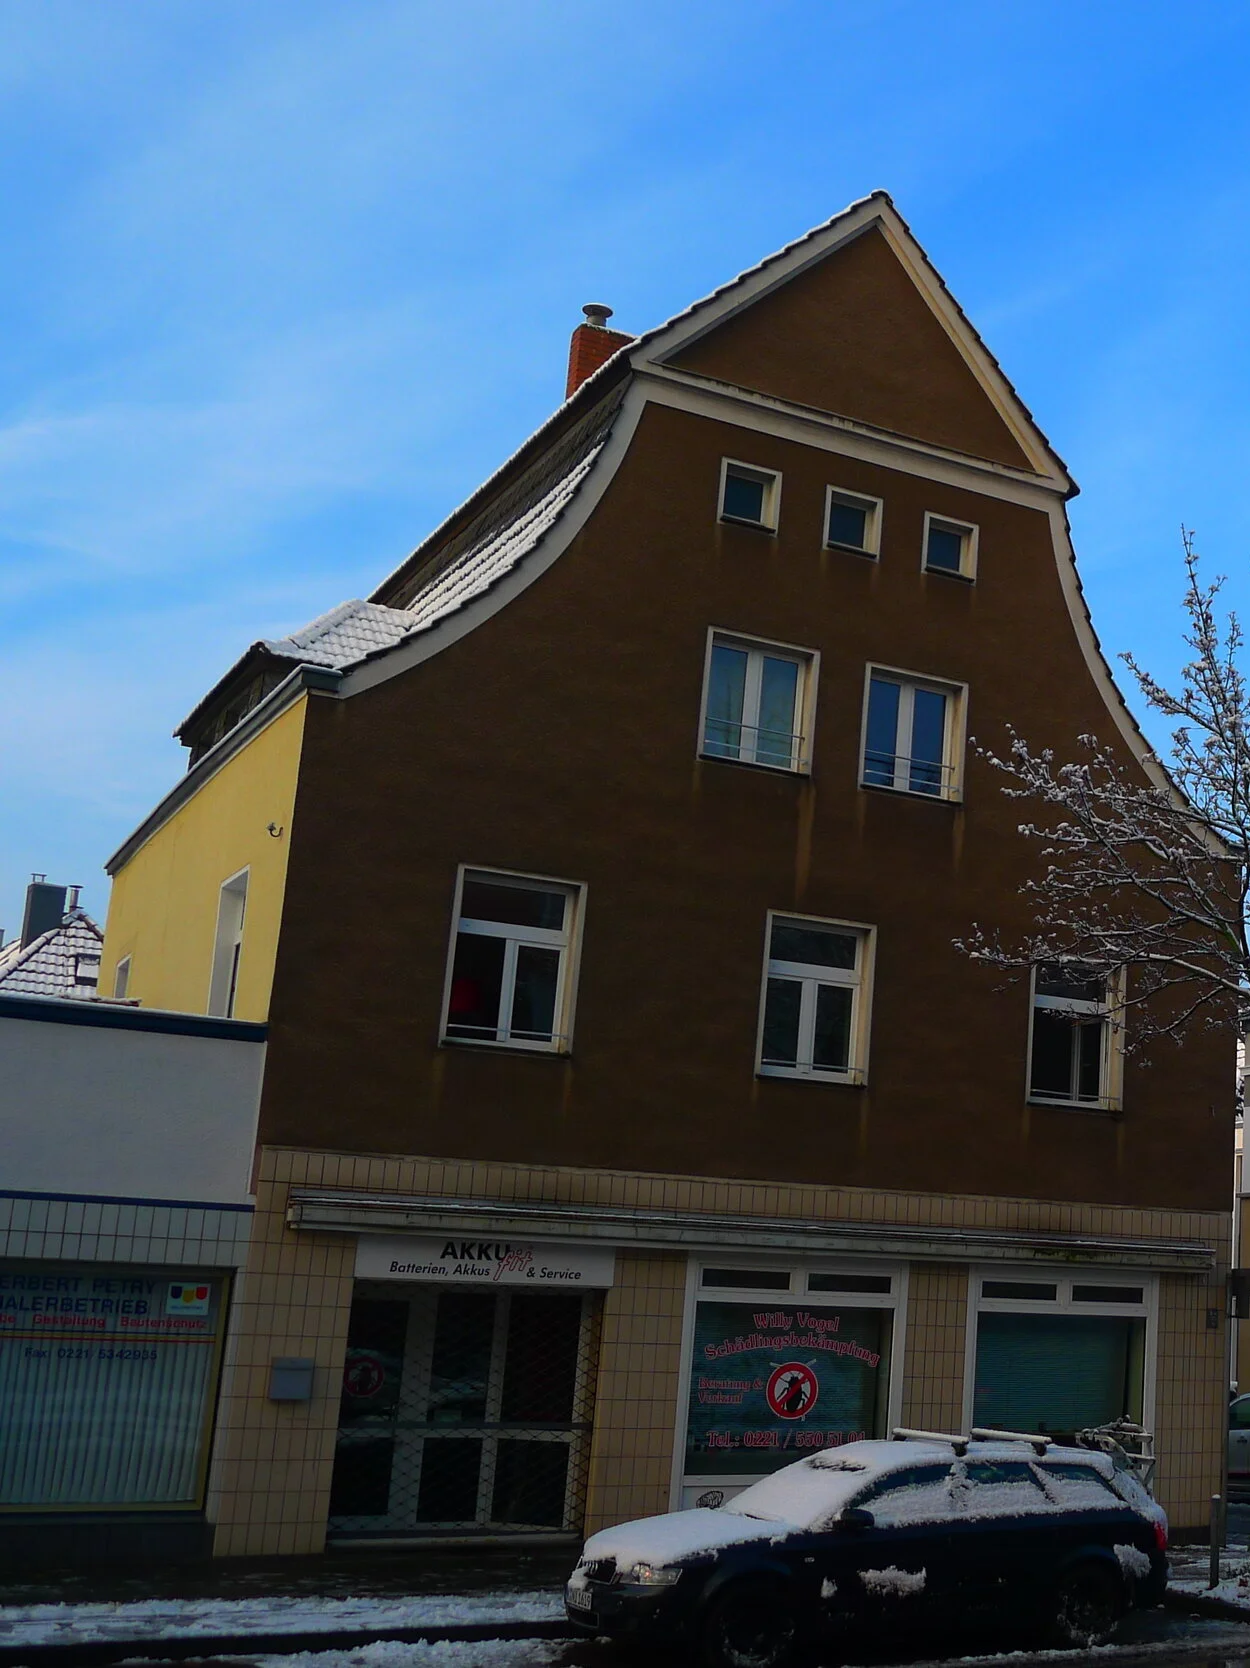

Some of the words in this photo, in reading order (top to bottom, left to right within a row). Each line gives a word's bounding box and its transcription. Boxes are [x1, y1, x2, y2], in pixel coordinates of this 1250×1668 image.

[440, 1241, 510, 1261] AKKU
[389, 1261, 449, 1277] Batterien,
[453, 1263, 491, 1277] Akkus
[526, 1266, 536, 1278] &
[539, 1267, 582, 1280] Service
[92, 1278, 157, 1295] PETRY
[33, 1313, 106, 1329] Gestaltung
[120, 1316, 208, 1330] Bautenschutz
[753, 1311, 793, 1331] Willy
[796, 1311, 840, 1333] Vogel
[57, 1348, 89, 1359] 0221
[704, 1331, 881, 1368] Schädlingsbekämpfung
[753, 1377, 763, 1389] &
[707, 1431, 740, 1448] Tel.:
[743, 1431, 779, 1448] 0221
[795, 1432, 823, 1448] 550
[827, 1432, 843, 1446] 51
